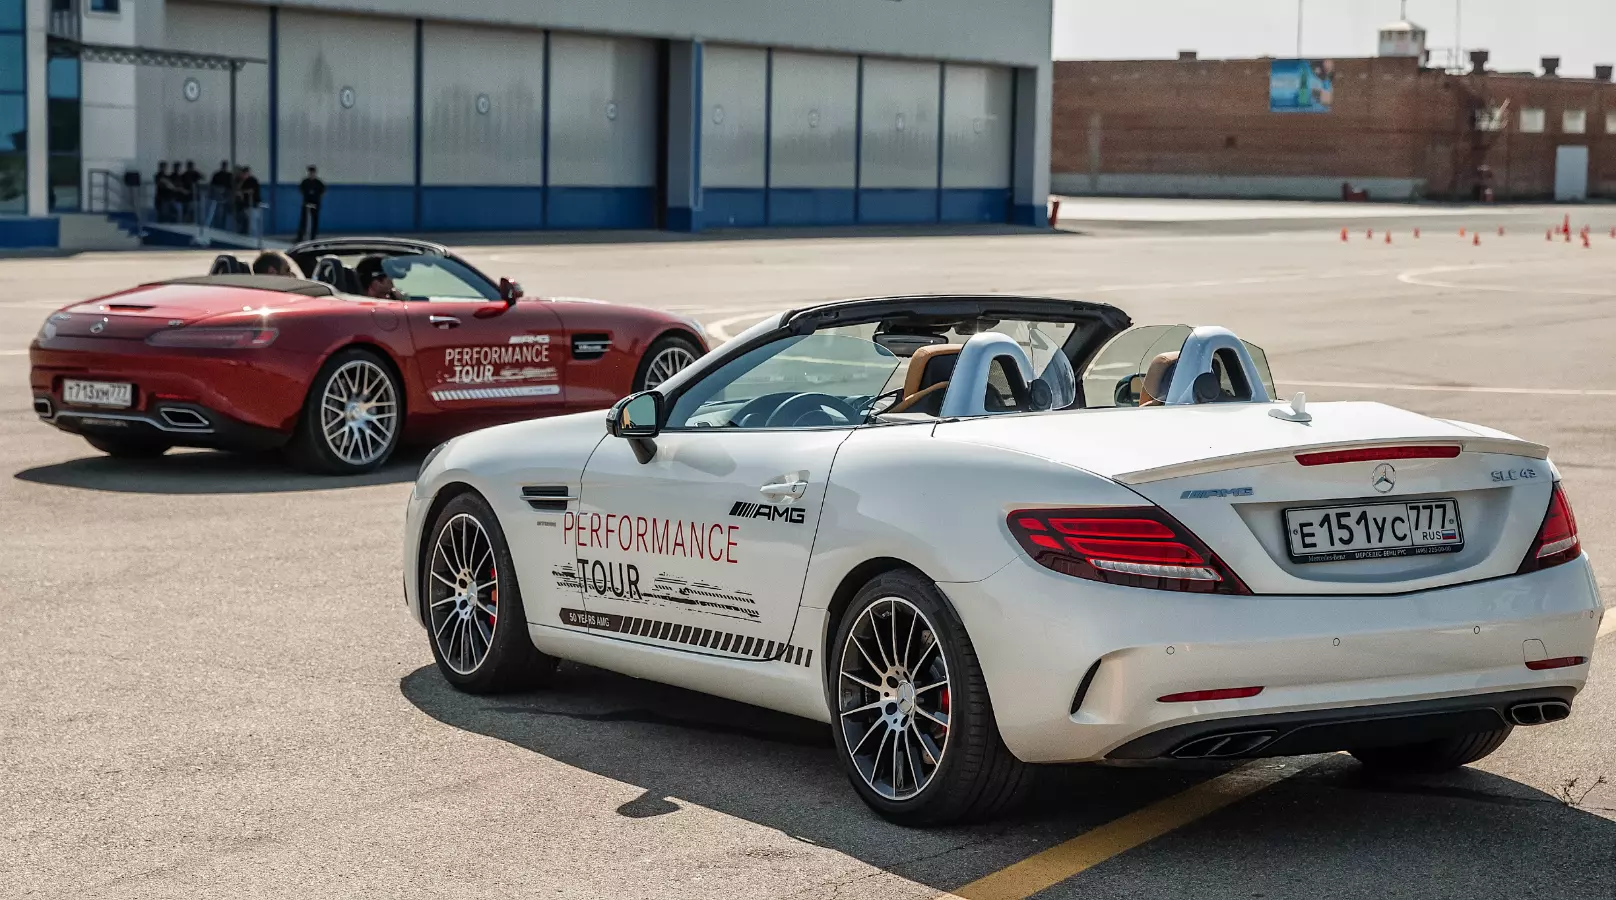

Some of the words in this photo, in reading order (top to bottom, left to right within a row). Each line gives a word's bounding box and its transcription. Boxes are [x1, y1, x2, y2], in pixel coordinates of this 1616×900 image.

[522, 335, 550, 344] AMG
[445, 345, 550, 366] PERFORMANCE
[453, 365, 494, 384] TOUR
[1491, 469, 1518, 482] SLC
[1208, 487, 1253, 498] AMG
[754, 504, 805, 524] AMG
[1409, 503, 1447, 531] 777
[563, 511, 740, 563] PERFORMANCE
[1422, 530, 1442, 541] RUS
[1308, 554, 1346, 562] Mercedes-Benz
[577, 558, 642, 600] TOUR
[569, 612, 577, 622] 50
[577, 613, 596, 625] YEARS
[596, 616, 610, 627] AMG
